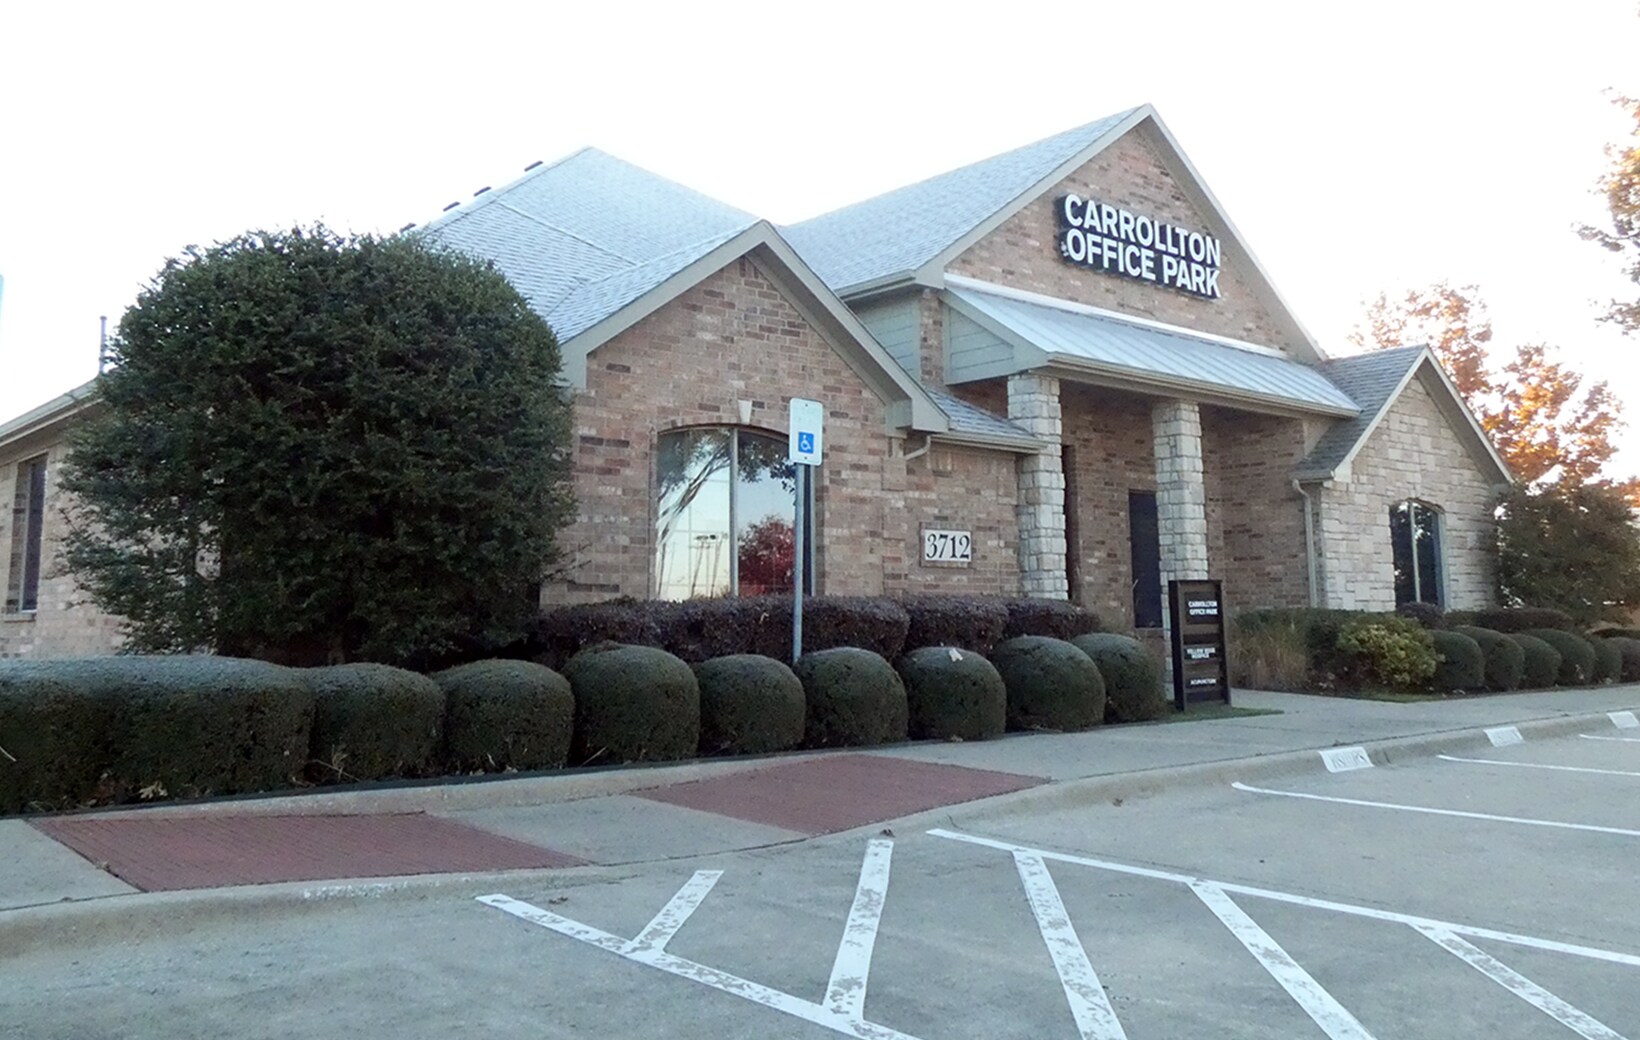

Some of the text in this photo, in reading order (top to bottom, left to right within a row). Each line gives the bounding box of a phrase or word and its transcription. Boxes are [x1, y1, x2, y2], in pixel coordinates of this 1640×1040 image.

[1064, 193, 1221, 267] CARROLLTON
[1066, 228, 1221, 298] OFFICE PARK
[926, 533, 970, 560] 3712
